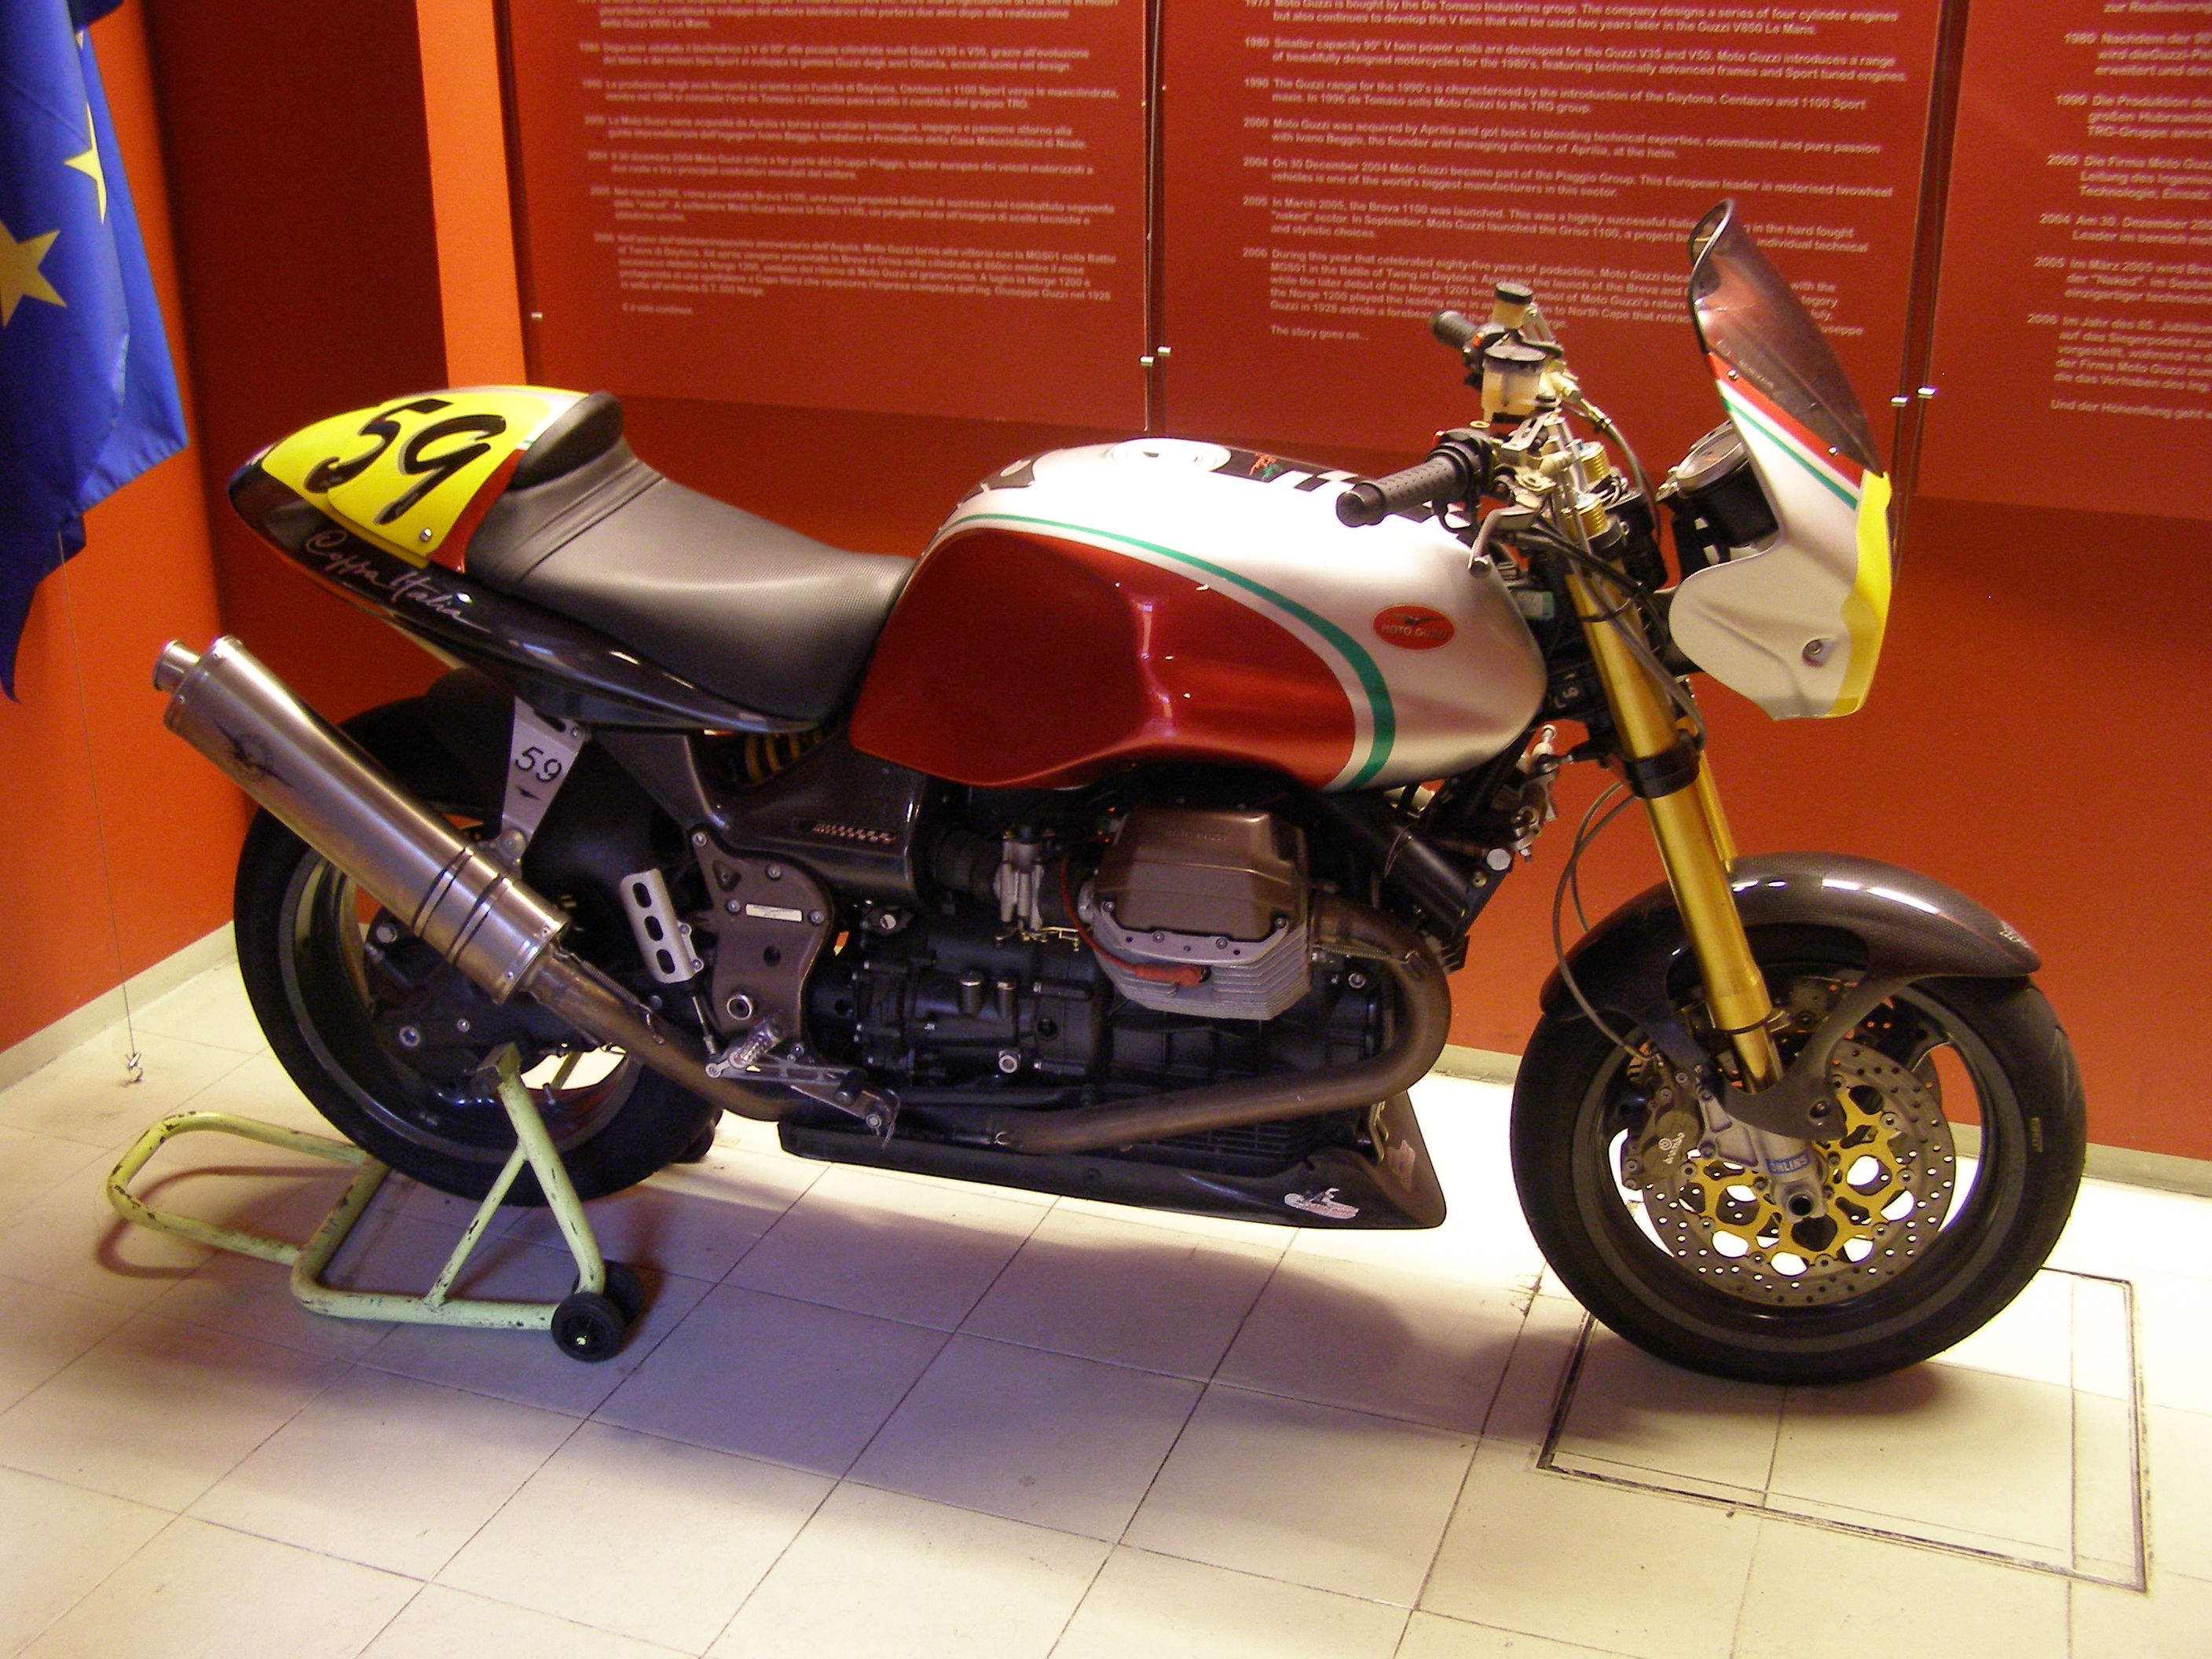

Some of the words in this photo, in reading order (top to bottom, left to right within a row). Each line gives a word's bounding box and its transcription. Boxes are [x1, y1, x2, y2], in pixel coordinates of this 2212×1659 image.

[1273, 11, 1290, 21] but
[1292, 12, 1314, 22] also
[1316, 12, 1368, 23] continues
[1383, 13, 1426, 27] develop
[1428, 15, 1445, 25] the
[1459, 16, 1482, 26] twin
[1484, 16, 1506, 27] that
[1508, 16, 1528, 27] will
[1546, 18, 1574, 28] used
[1577, 18, 1597, 29] two
[1599, 20, 1631, 32] years
[1633, 20, 1659, 31] later
[1675, 21, 1694, 31] the
[1697, 21, 1730, 32] Guzzi
[1582, 5, 1602, 15] The
[1604, 7, 1657, 19] company
[1717, 8, 1753, 19] series
[1771, 9, 1795, 20] four
[1798, 10, 1845, 24] cylinder
[1849, 11, 1897, 24] engines
[1273, 38, 1313, 49] Smaller
[1316, 38, 1361, 53] capacity
[1393, 41, 1416, 52] twin
[1418, 43, 1452, 55] power
[1455, 43, 1482, 53] units
[1505, 45, 1563, 58] developed
[1604, 48, 1636, 58] Guzzi
[1716, 51, 1745, 62] Moto
[1748, 52, 1781, 63] Guzzi
[1783, 53, 1846, 65] introduces
[1859, 57, 1895, 68] range
[1274, 78, 1292, 89] The
[1295, 79, 1324, 90] Guzzi
[1326, 82, 1357, 93] range
[1559, 88, 1628, 101] introduction
[1719, 94, 1773, 106] Centauro
[1801, 97, 1829, 108] 1100
[1831, 98, 1865, 112] Sport
[1306, 93, 1317, 103] In
[1433, 97, 1461, 108] Moto
[1462, 98, 1494, 109] Guzzi
[1509, 101, 1527, 111] the
[1530, 101, 1554, 112] TRG
[1243, 116, 1268, 127] 2000
[1273, 118, 1298, 129] Moto
[1300, 119, 1330, 130] Guzzi
[1332, 122, 1353, 131] was
[1355, 122, 1403, 136] acquired
[1419, 124, 1456, 137] Aprilia
[1500, 127, 1526, 138] back
[1542, 130, 1591, 144] blending
[1593, 131, 1645, 144] technical
[1804, 142, 1831, 154] pure
[1833, 141, 1880, 156] passion
[1243, 156, 1267, 167] 2004
[1272, 157, 1287, 168] On
[1290, 158, 1302, 169] 30
[1304, 159, 1357, 171] December
[1361, 162, 1386, 173] 2004
[1389, 163, 1415, 174] Moto
[1417, 164, 1448, 176] Guzzi
[1449, 166, 1493, 178] became
[1495, 168, 1518, 181] part
[1555, 171, 1596, 185] Piaggio
[1640, 175, 1662, 186] This
[1664, 176, 1719, 191] European
[1721, 179, 1757, 191] leader
[1774, 181, 1833, 194] motorised
[1272, 196, 1282, 207] In
[1284, 197, 1316, 208] March
[1349, 200, 1366, 211] the
[1368, 202, 1399, 213] Breva
[1402, 203, 1427, 214] 1100
[1429, 207, 1451, 216] was
[1271, 248, 1306, 262] During
[1308, 251, 1327, 262] this
[1329, 254, 1351, 266] year
[1354, 253, 1375, 264] that
[1270, 324, 1289, 335] The
[1291, 326, 1317, 340] story
[1318, 330, 1344, 342] goes
[303, 398, 507, 525] 59
[515, 746, 562, 782] 59
